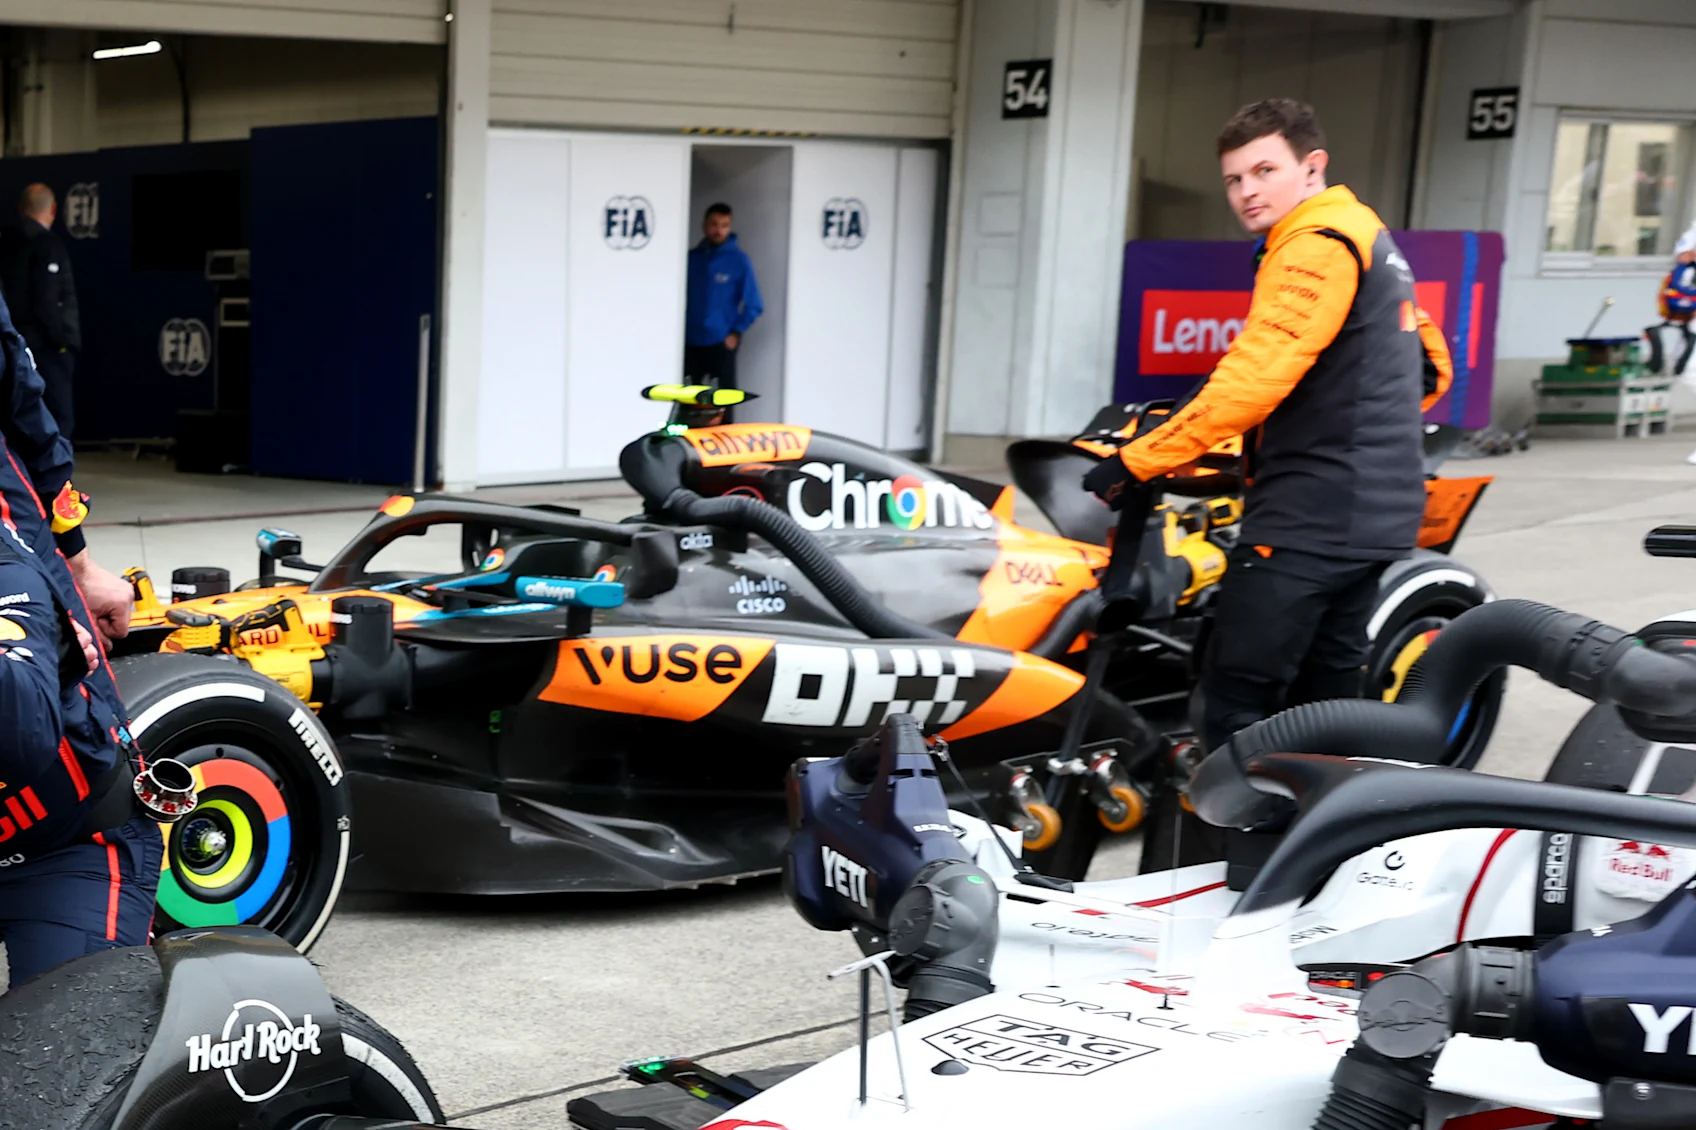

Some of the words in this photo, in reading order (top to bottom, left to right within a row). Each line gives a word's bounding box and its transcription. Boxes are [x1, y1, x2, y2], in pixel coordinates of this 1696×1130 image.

[1005, 69, 1048, 110] 54
[1471, 97, 1515, 132] 55
[787, 462, 994, 531] Chrome
[524, 581, 576, 601] allwyn
[1005, 562, 1064, 587] DELL
[288, 707, 344, 787] PIRELLI
[821, 845, 869, 909] YETI
[1544, 832, 1573, 905] sparco
[1609, 858, 1641, 881] Red
[1640, 860, 1674, 883] Bull
[998, 1019, 1132, 1056] TAG
[1018, 992, 1238, 1043] ORACLE
[185, 1023, 255, 1074] Hard
[255, 1013, 322, 1064] Rock
[942, 1033, 1095, 1072] HEUER
